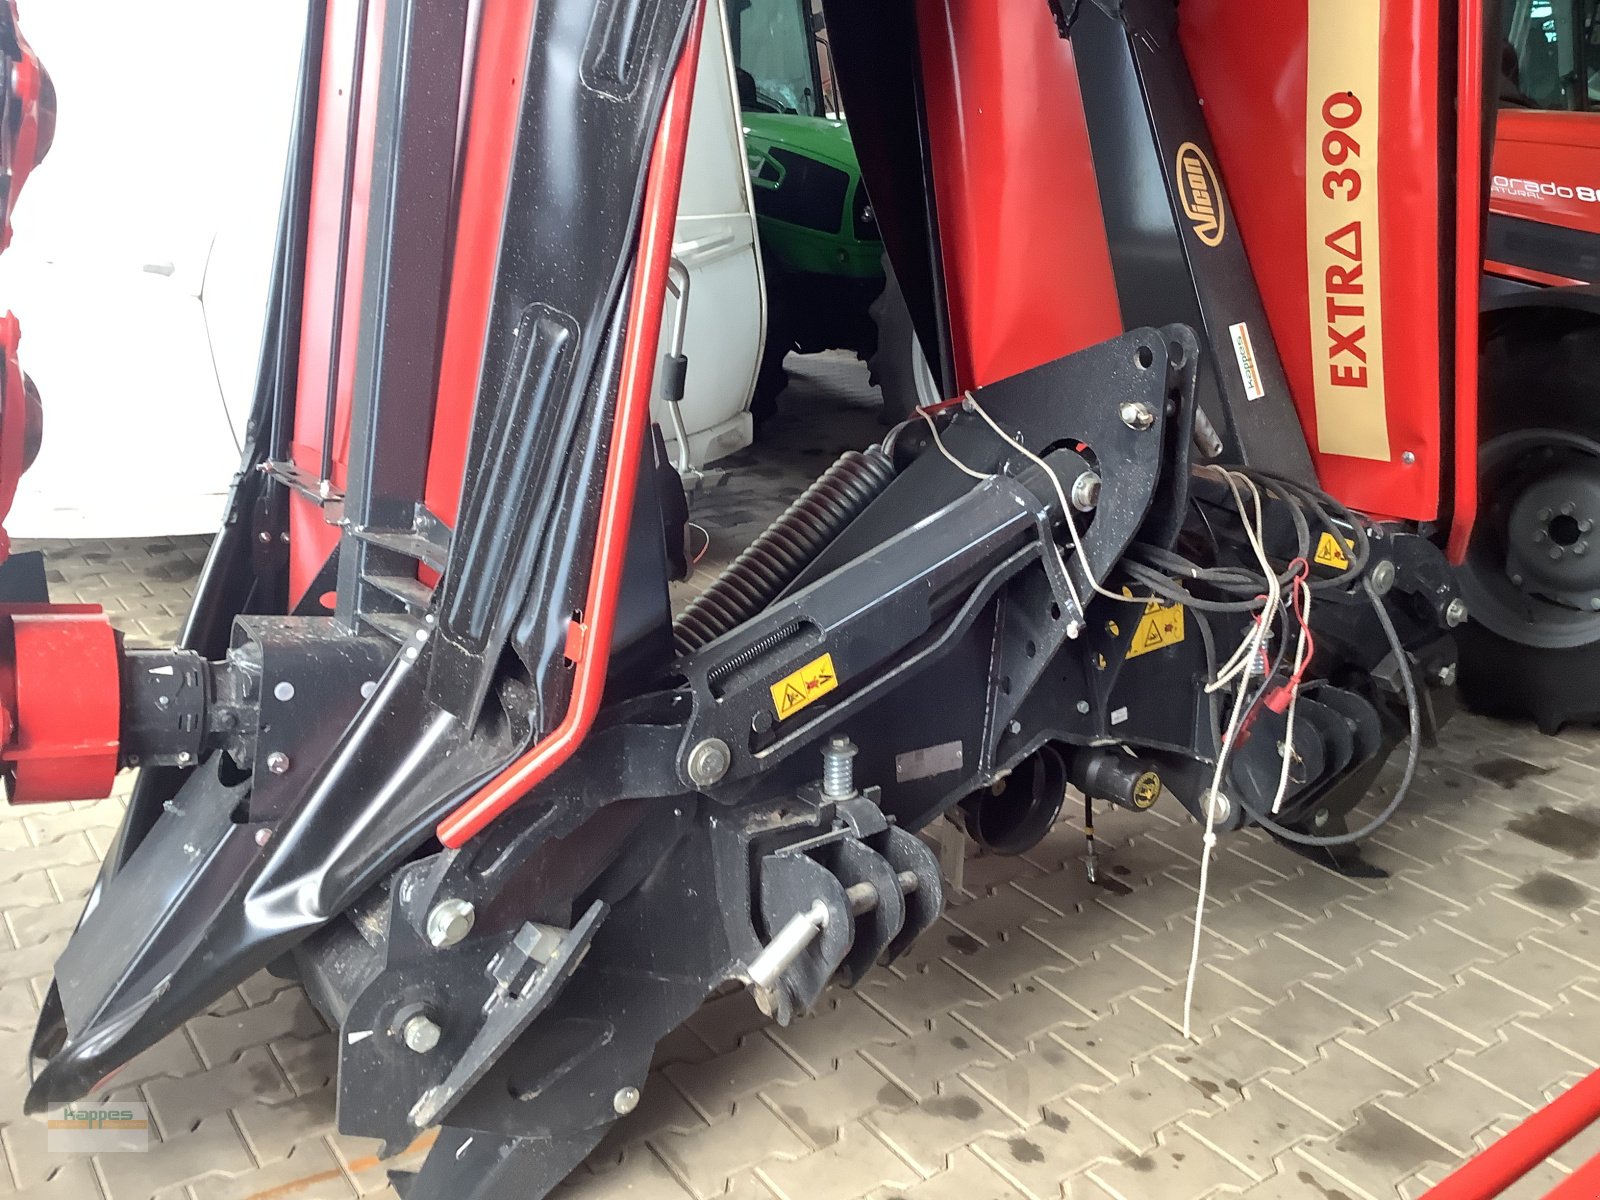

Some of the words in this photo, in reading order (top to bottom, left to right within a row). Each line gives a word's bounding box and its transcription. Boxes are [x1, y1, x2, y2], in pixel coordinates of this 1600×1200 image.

[1322, 91, 1363, 202] 390
[1490, 185, 1545, 201] ATURAL
[1492, 175, 1574, 199] orado
[1180, 154, 1221, 247] Vicon
[1325, 220, 1368, 389] EXTRA
